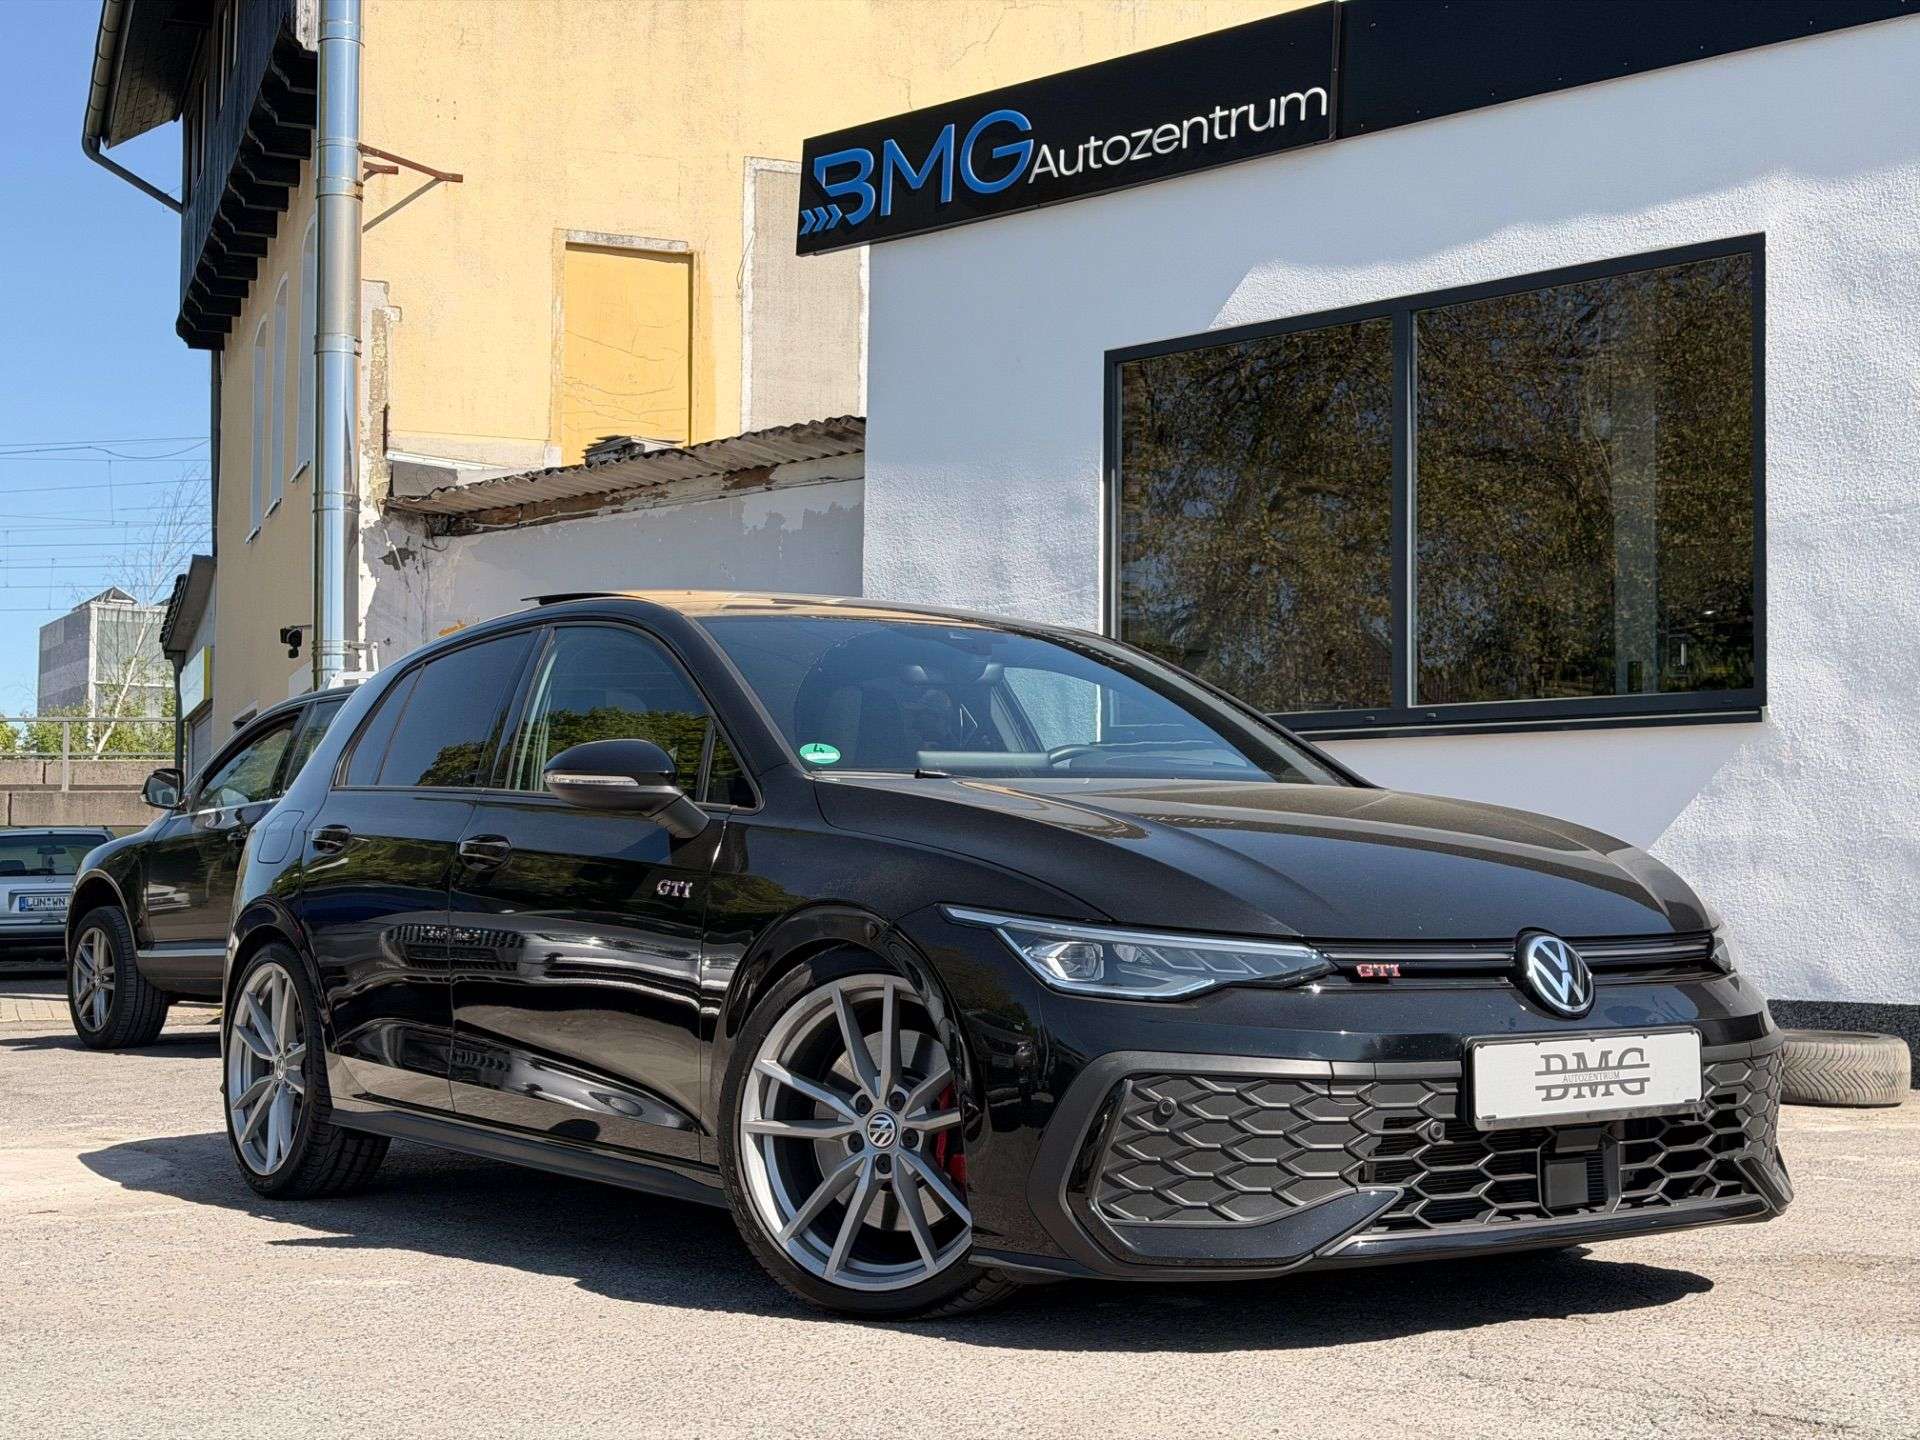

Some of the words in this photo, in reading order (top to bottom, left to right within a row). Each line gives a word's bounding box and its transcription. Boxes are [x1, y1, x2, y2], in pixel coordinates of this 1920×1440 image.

[814, 108, 1034, 225] BMG
[1028, 86, 1328, 184] Autozentrum
[656, 879, 693, 898] GTI
[1356, 963, 1401, 977] GTI
[1528, 936, 1594, 1012] VW
[1563, 1071, 1621, 1084] AUTOZENTRUM
